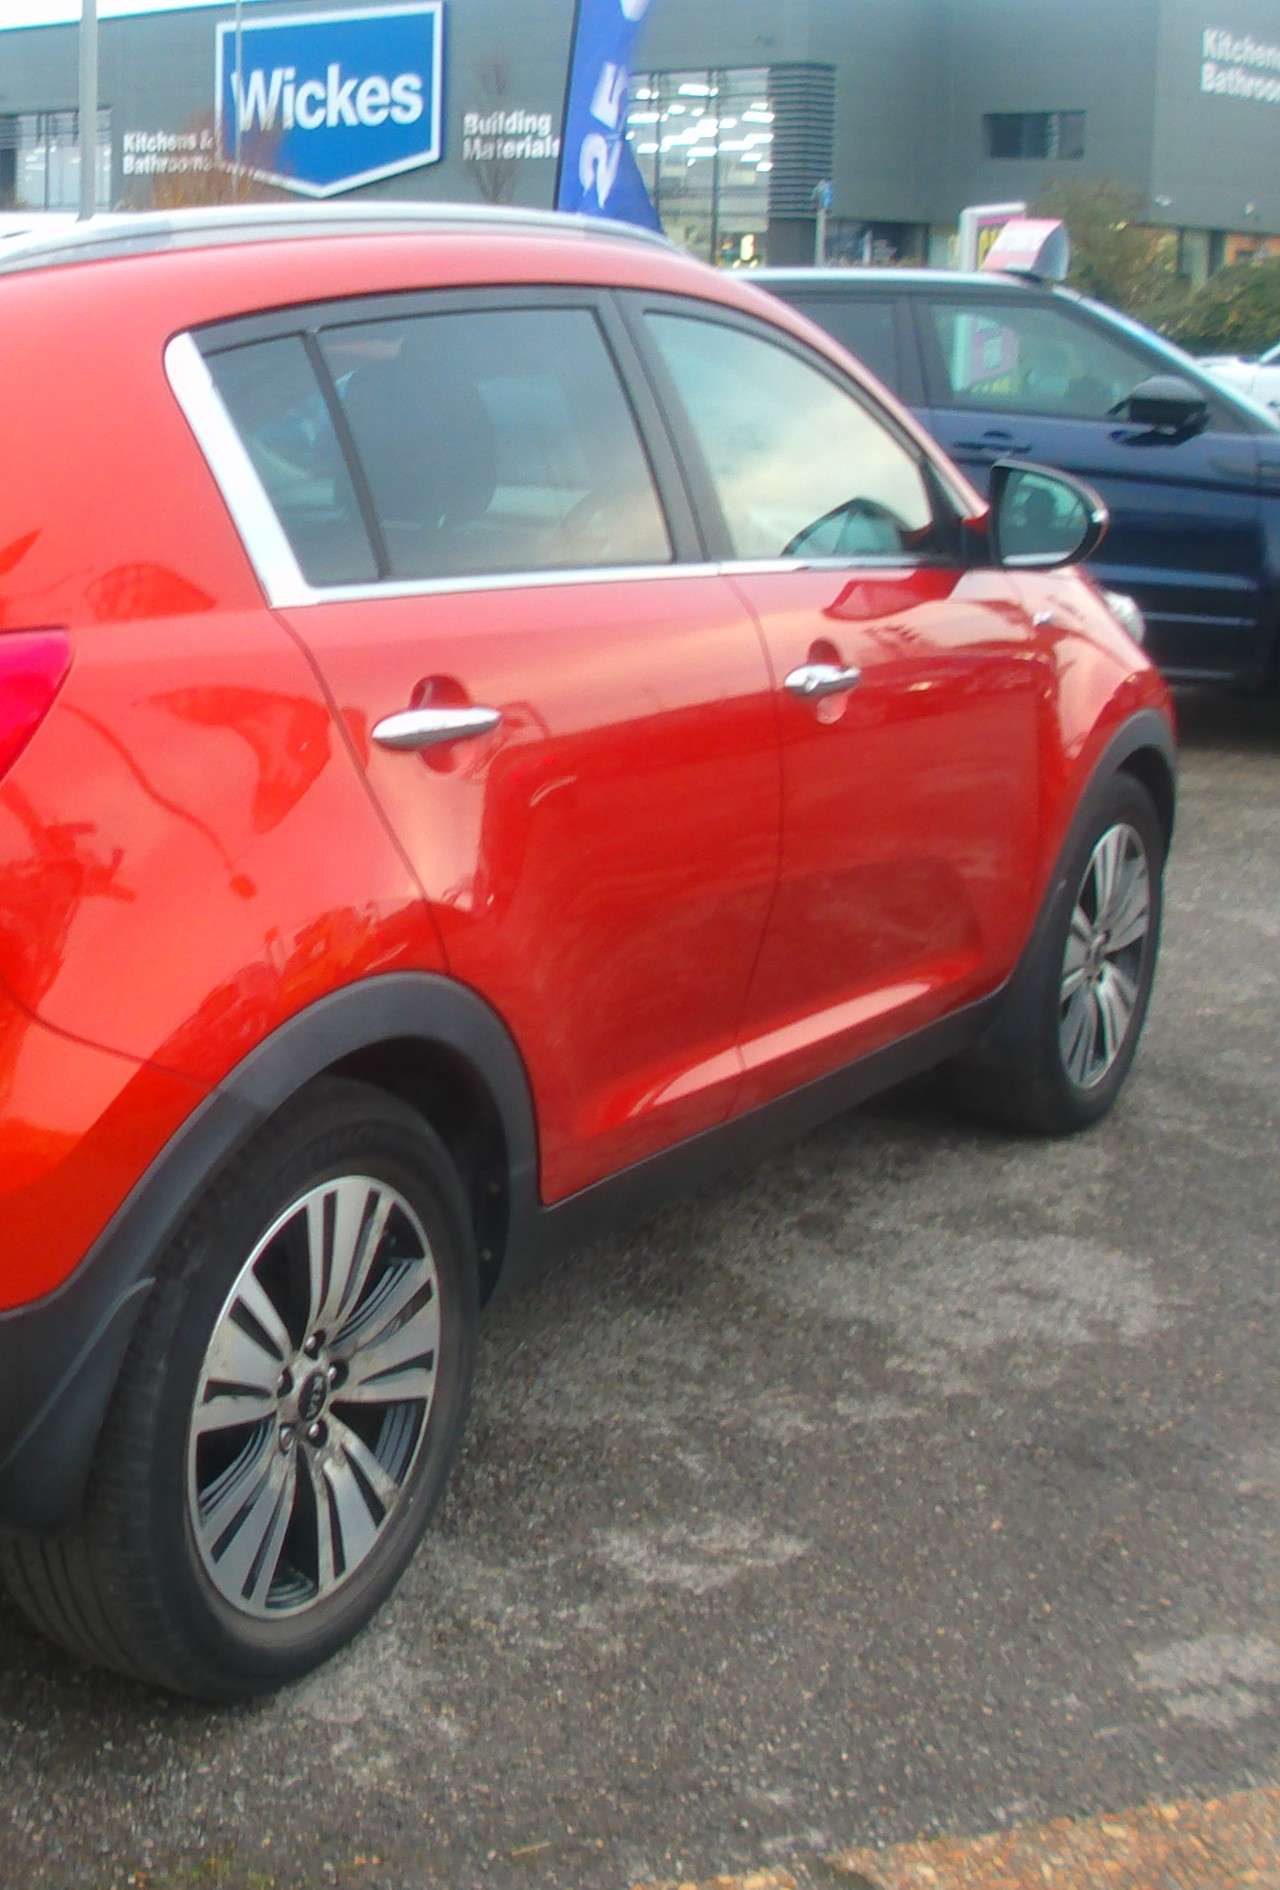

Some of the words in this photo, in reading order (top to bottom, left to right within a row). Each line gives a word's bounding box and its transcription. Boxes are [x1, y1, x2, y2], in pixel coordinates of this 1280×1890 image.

[231, 62, 424, 132] Wickes
[463, 109, 553, 137] Building
[123, 131, 197, 153] Kitchens
